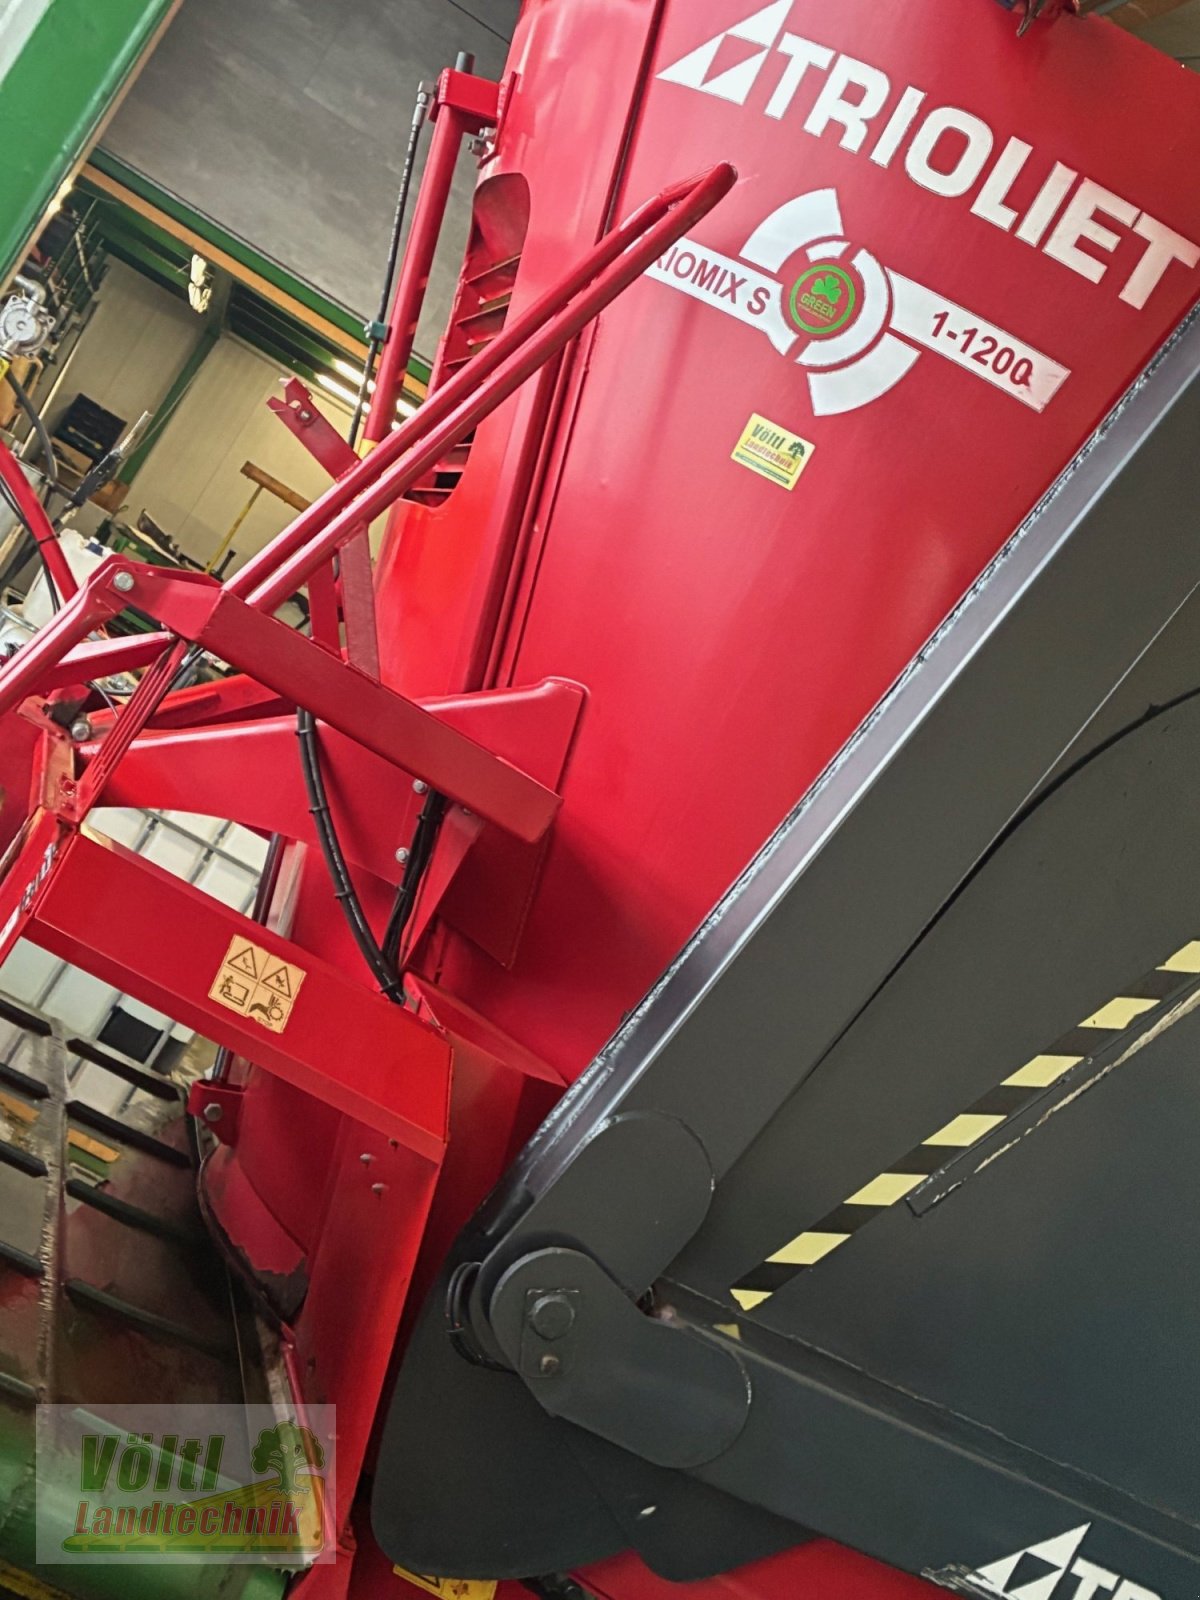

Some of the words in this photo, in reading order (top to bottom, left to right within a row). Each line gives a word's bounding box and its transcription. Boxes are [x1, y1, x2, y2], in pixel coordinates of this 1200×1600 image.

[764, 32, 1200, 310] TRIOLIET
[801, 293, 836, 318] GREEN
[747, 286, 771, 315] S
[931, 311, 1033, 387] 1-1200
[751, 424, 786, 450] Völtl
[745, 438, 793, 469] Landtechnik
